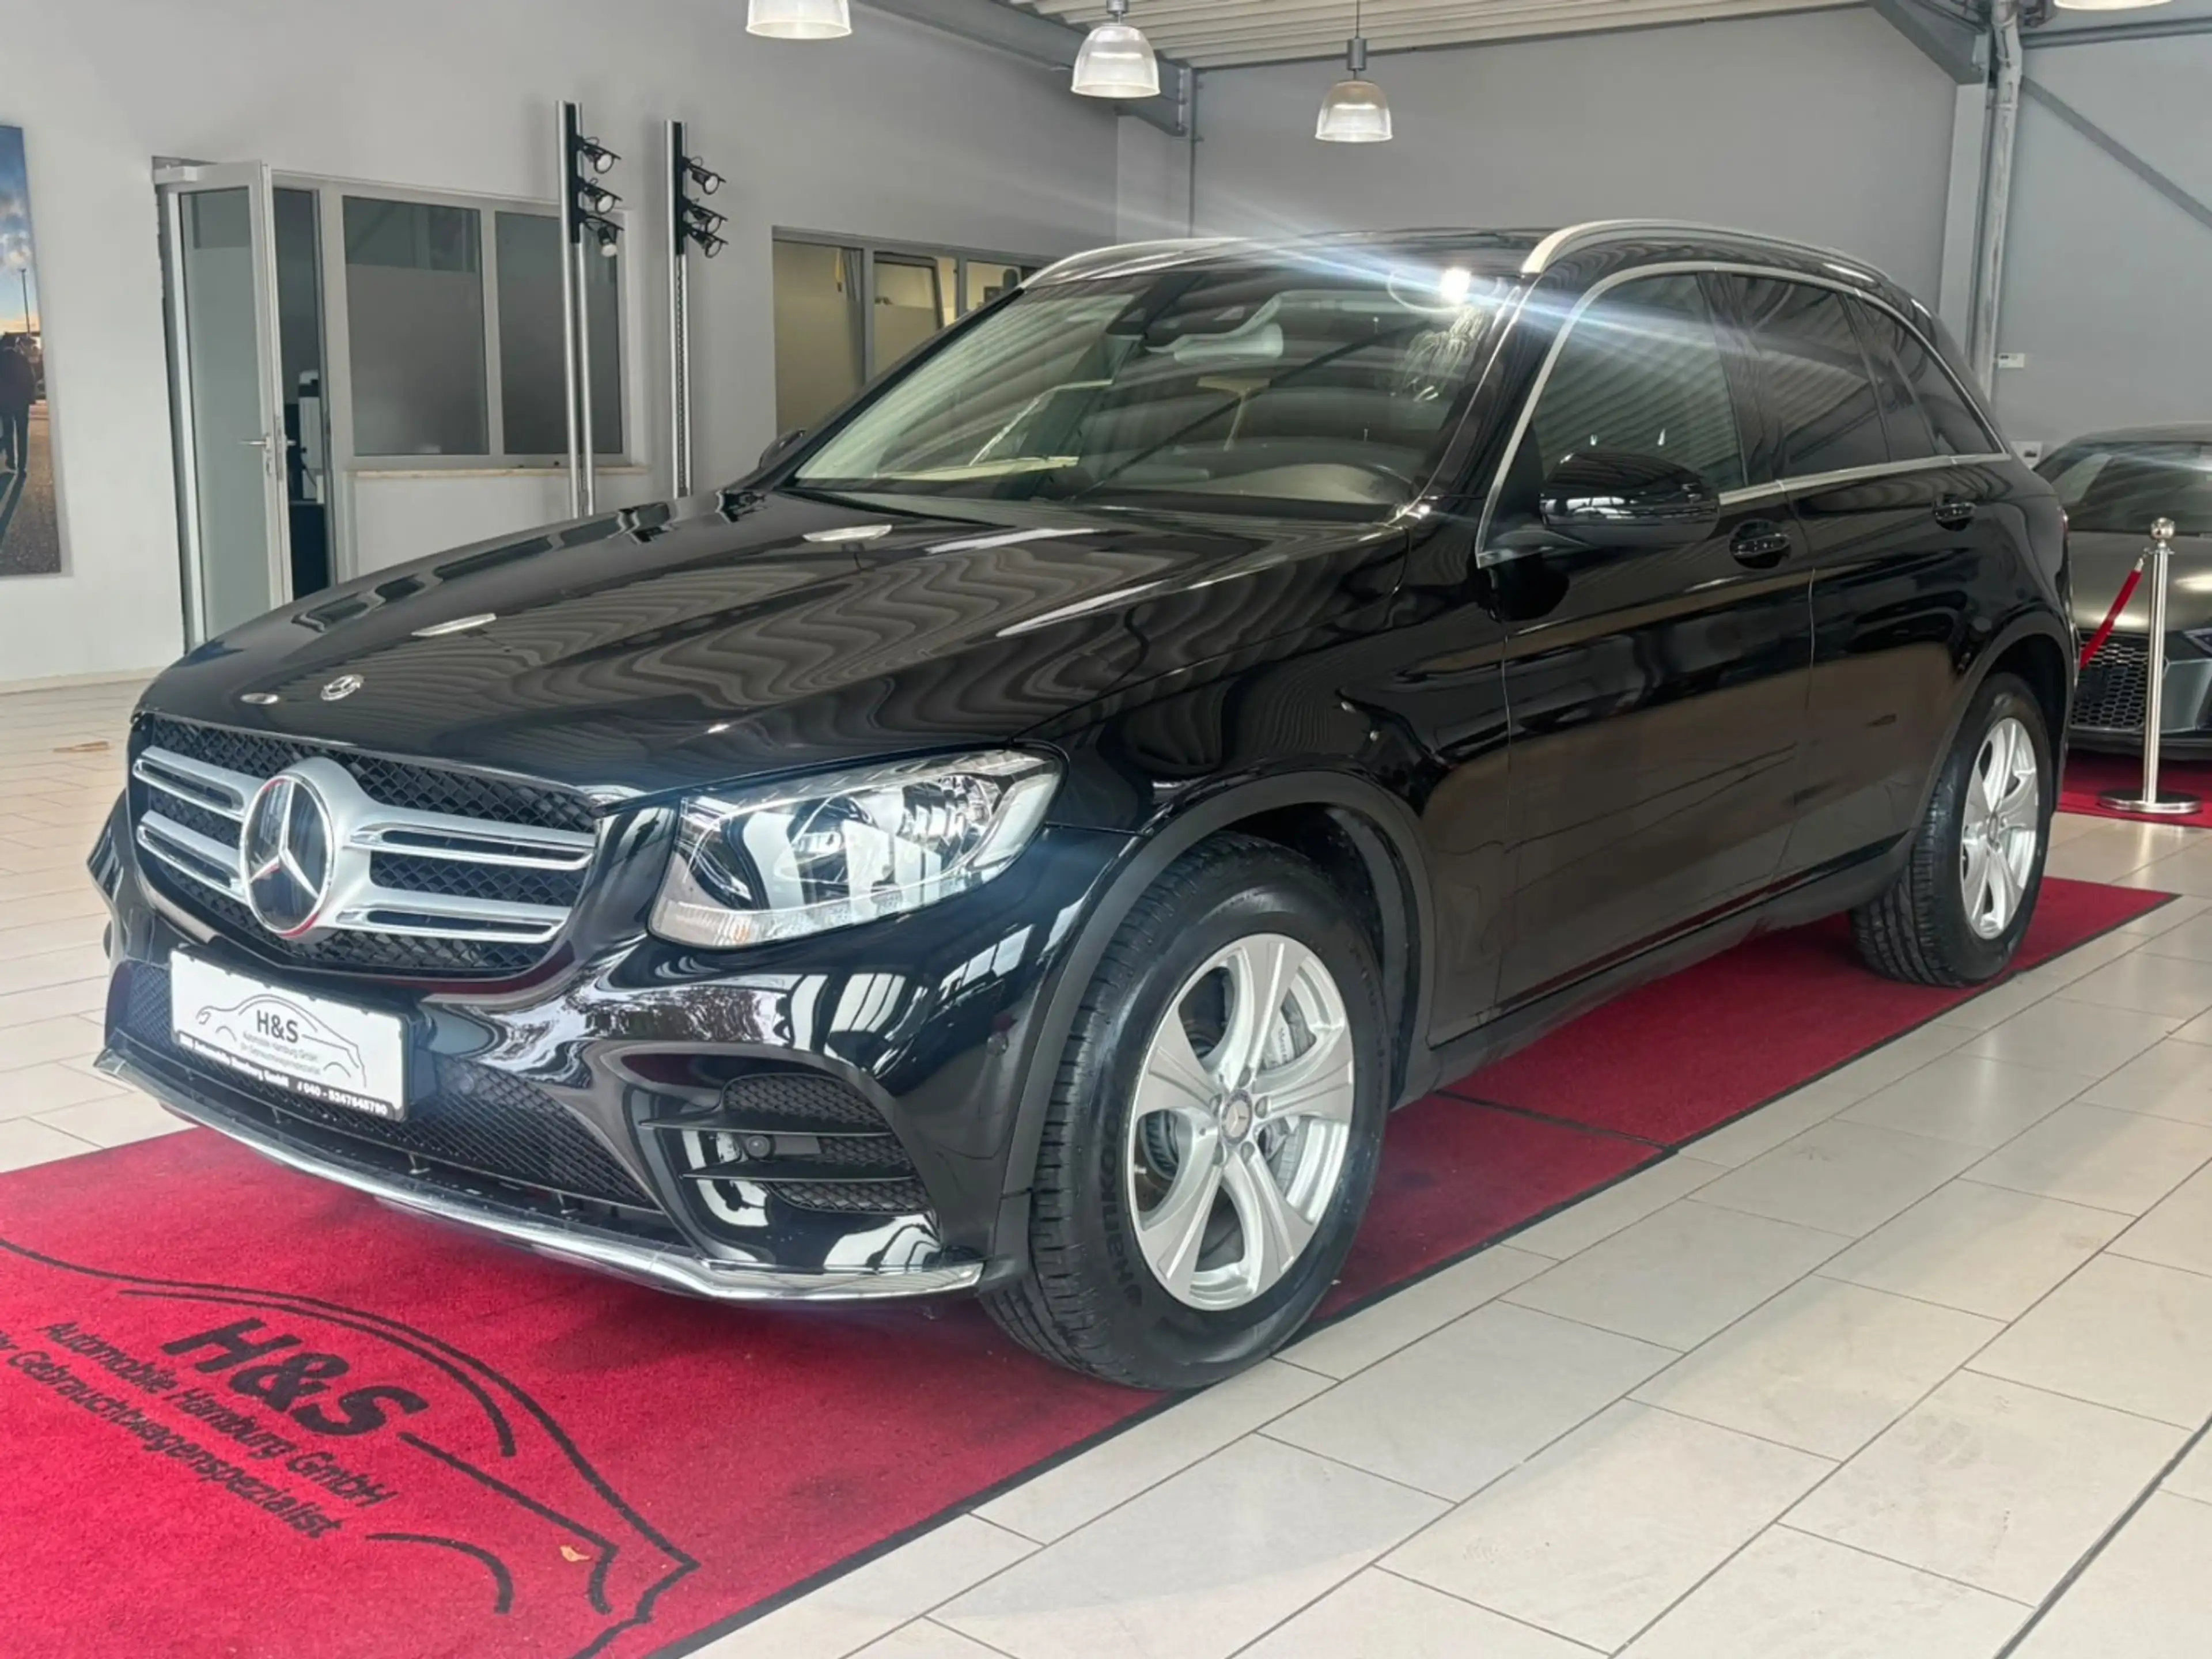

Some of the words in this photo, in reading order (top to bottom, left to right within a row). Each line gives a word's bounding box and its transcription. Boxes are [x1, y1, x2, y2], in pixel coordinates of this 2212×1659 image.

[256, 1009, 298, 1044] H&S
[7, 1351, 343, 1539] Gebrauchtwagenspezialist
[35, 1321, 177, 1394] Automobile
[162, 1388, 297, 1460] Hamburg
[286, 1452, 399, 1507] GmbH
[160, 1317, 430, 1436] H&S
